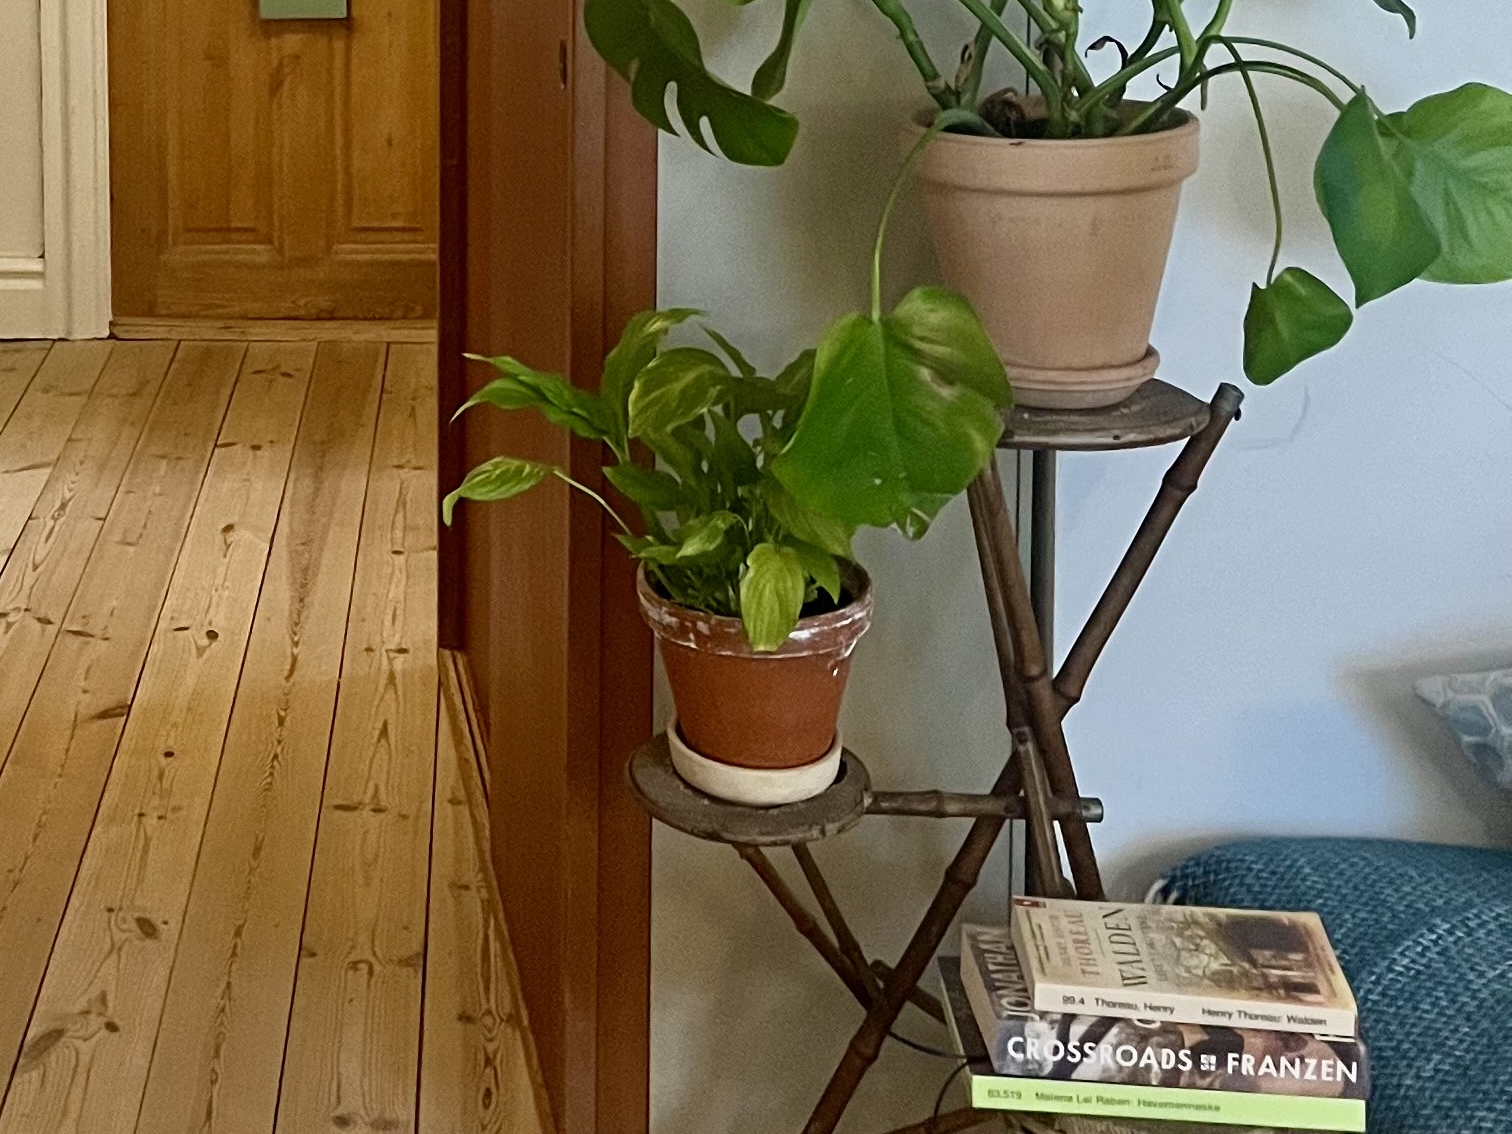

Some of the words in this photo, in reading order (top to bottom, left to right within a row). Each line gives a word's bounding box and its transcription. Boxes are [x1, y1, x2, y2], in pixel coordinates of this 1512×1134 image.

[1102, 907, 1149, 987] WALDEN
[1144, 1002, 1175, 1015] Henry
[1201, 1007, 1233, 1021] Henry
[1286, 1014, 1327, 1026] Walden
[1006, 1036, 1193, 1072] CROSSROADS
[1227, 1052, 1358, 1084] FRANZEN
